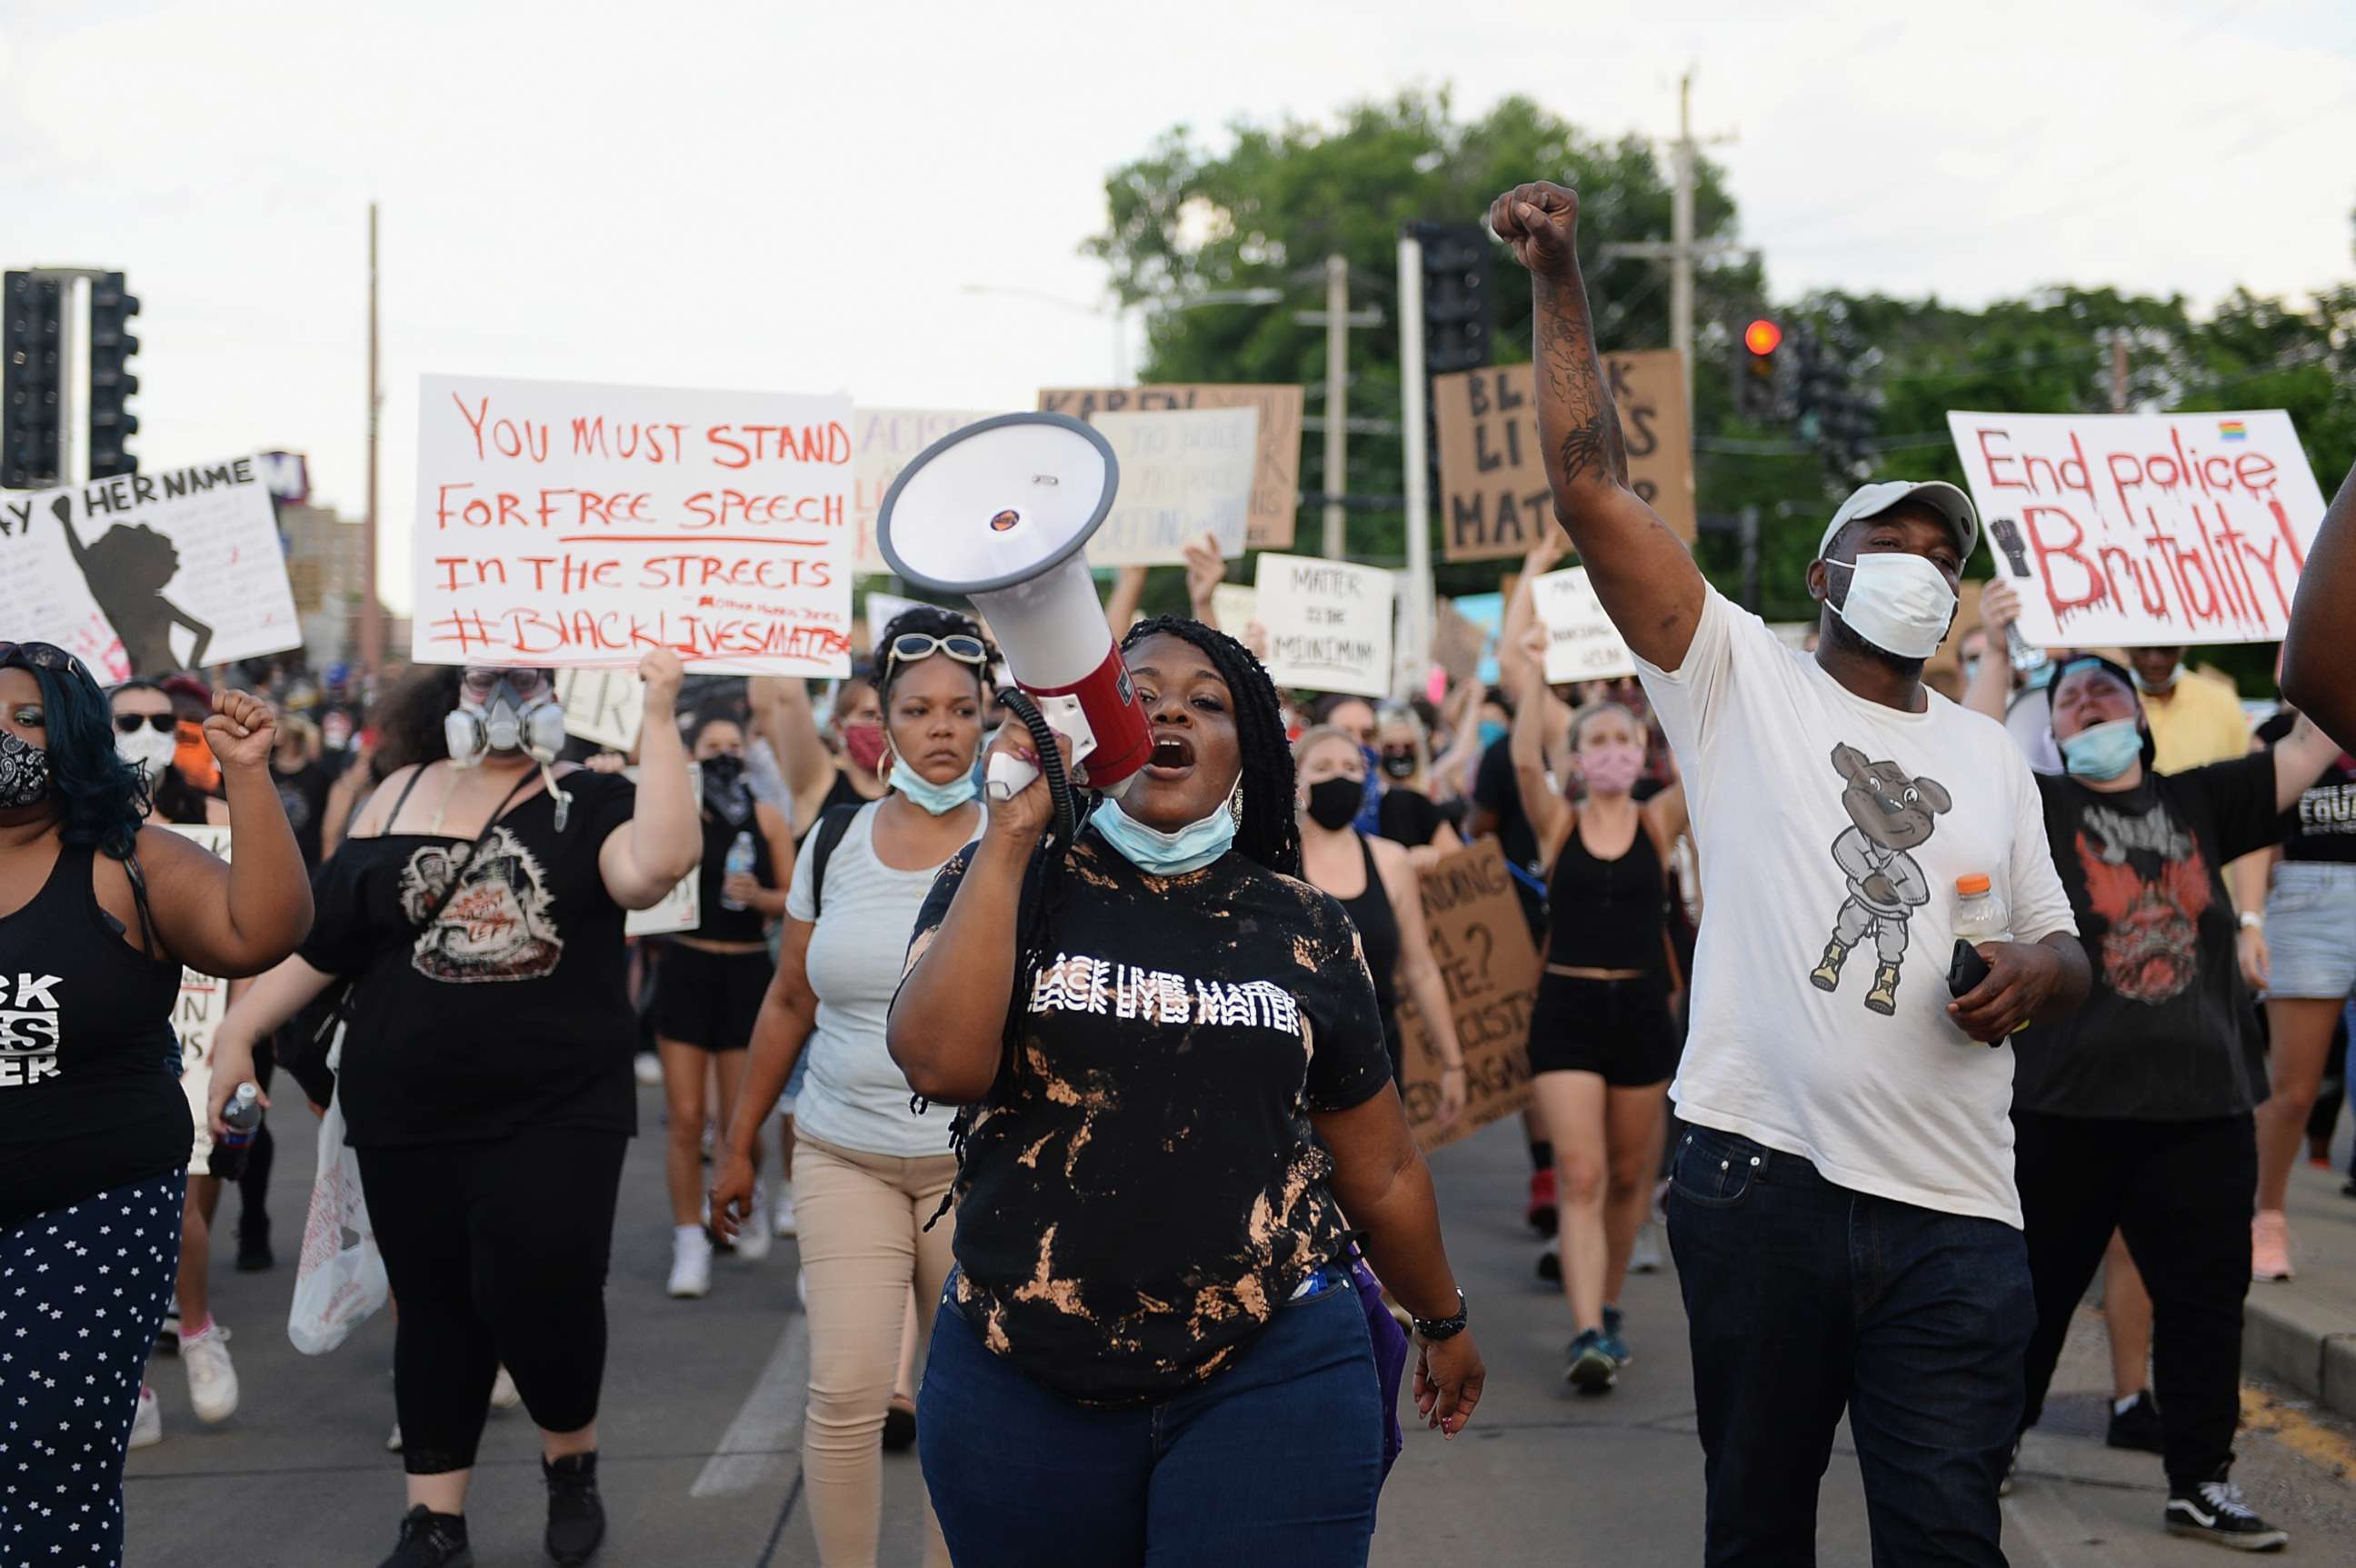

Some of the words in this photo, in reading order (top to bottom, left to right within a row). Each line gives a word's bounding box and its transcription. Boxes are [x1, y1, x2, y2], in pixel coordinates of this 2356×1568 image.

[1468, 358, 1633, 418] BLK
[453, 391, 547, 464] YOU
[571, 415, 691, 464] MUST
[706, 421, 853, 469] STAND
[83, 475, 158, 518] HER
[162, 457, 256, 500] NAME
[1976, 430, 2095, 500] End
[2107, 424, 2277, 527] police
[436, 483, 529, 530] FOR
[536, 487, 656, 528] FREE
[678, 489, 844, 529] SPEECH
[516, 553, 623, 594] THE
[638, 554, 832, 589] STREETS
[0, 972, 65, 1009] K
[1030, 951, 1112, 1015] LACK
[1115, 964, 1190, 1024] LIVES
[1194, 977, 1300, 1037] MATTER
